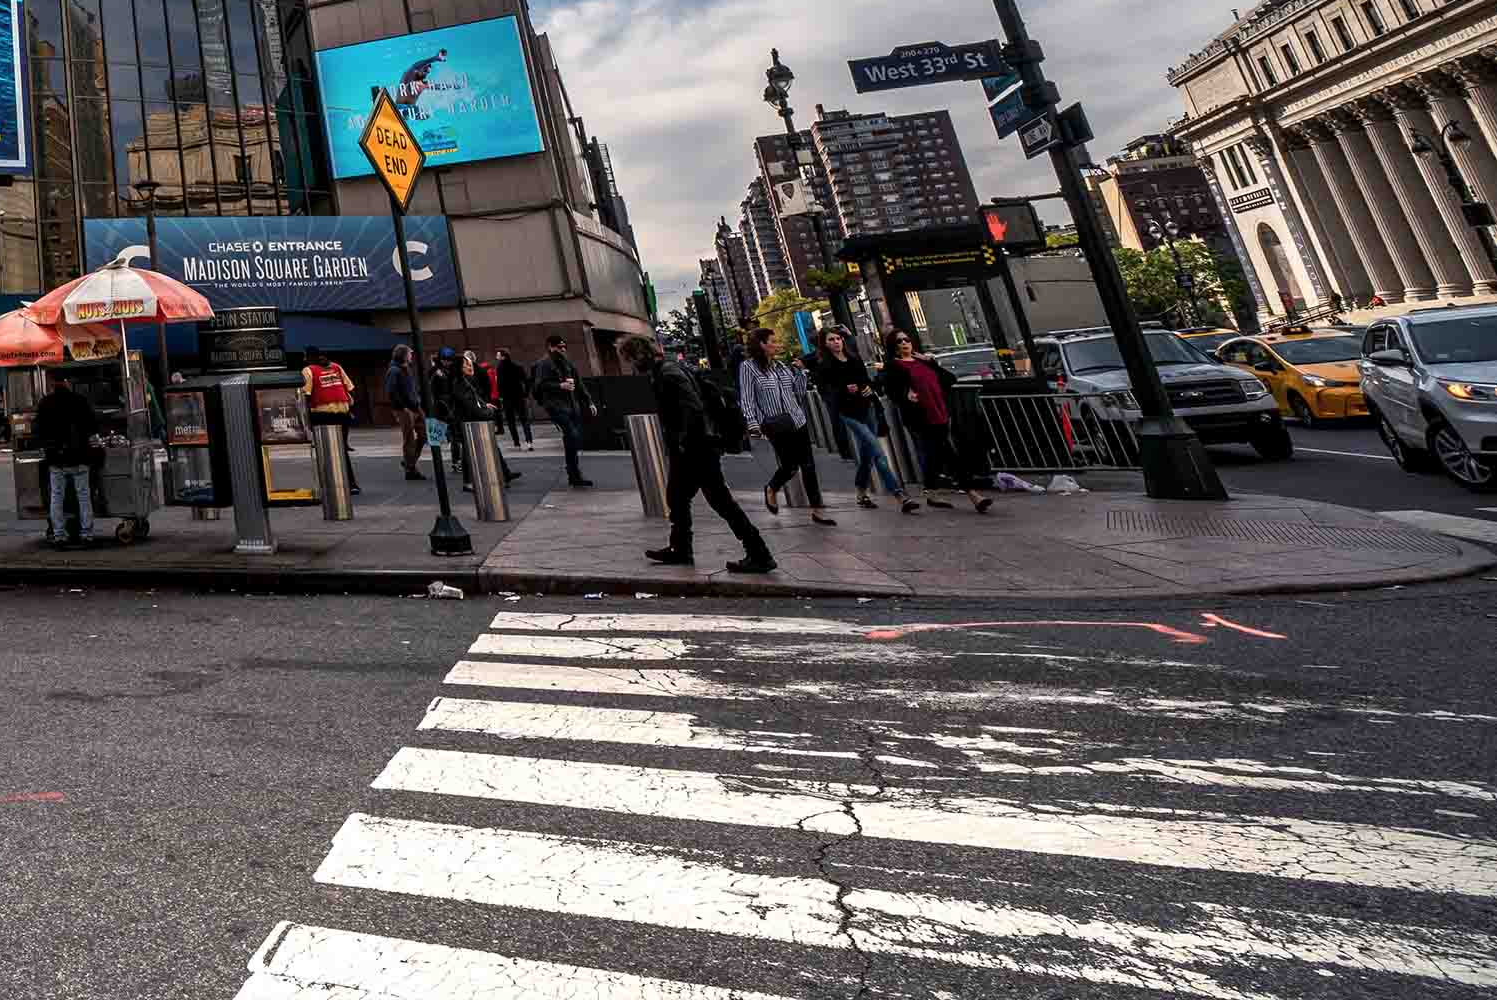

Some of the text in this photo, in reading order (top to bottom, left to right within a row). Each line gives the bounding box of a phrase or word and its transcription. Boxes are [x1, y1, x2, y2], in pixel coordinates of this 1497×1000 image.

[864, 53, 988, 83] West 33rd St
[376, 126, 408, 150] DEAD
[384, 154, 408, 176] END
[208, 240, 343, 253] CHASE ENTRANCE
[183, 255, 369, 281] MADISON SQUARE GARDEN
[392, 240, 433, 281] C
[288, 280, 318, 288] FAMOUS
[239, 311, 279, 327] STATION
